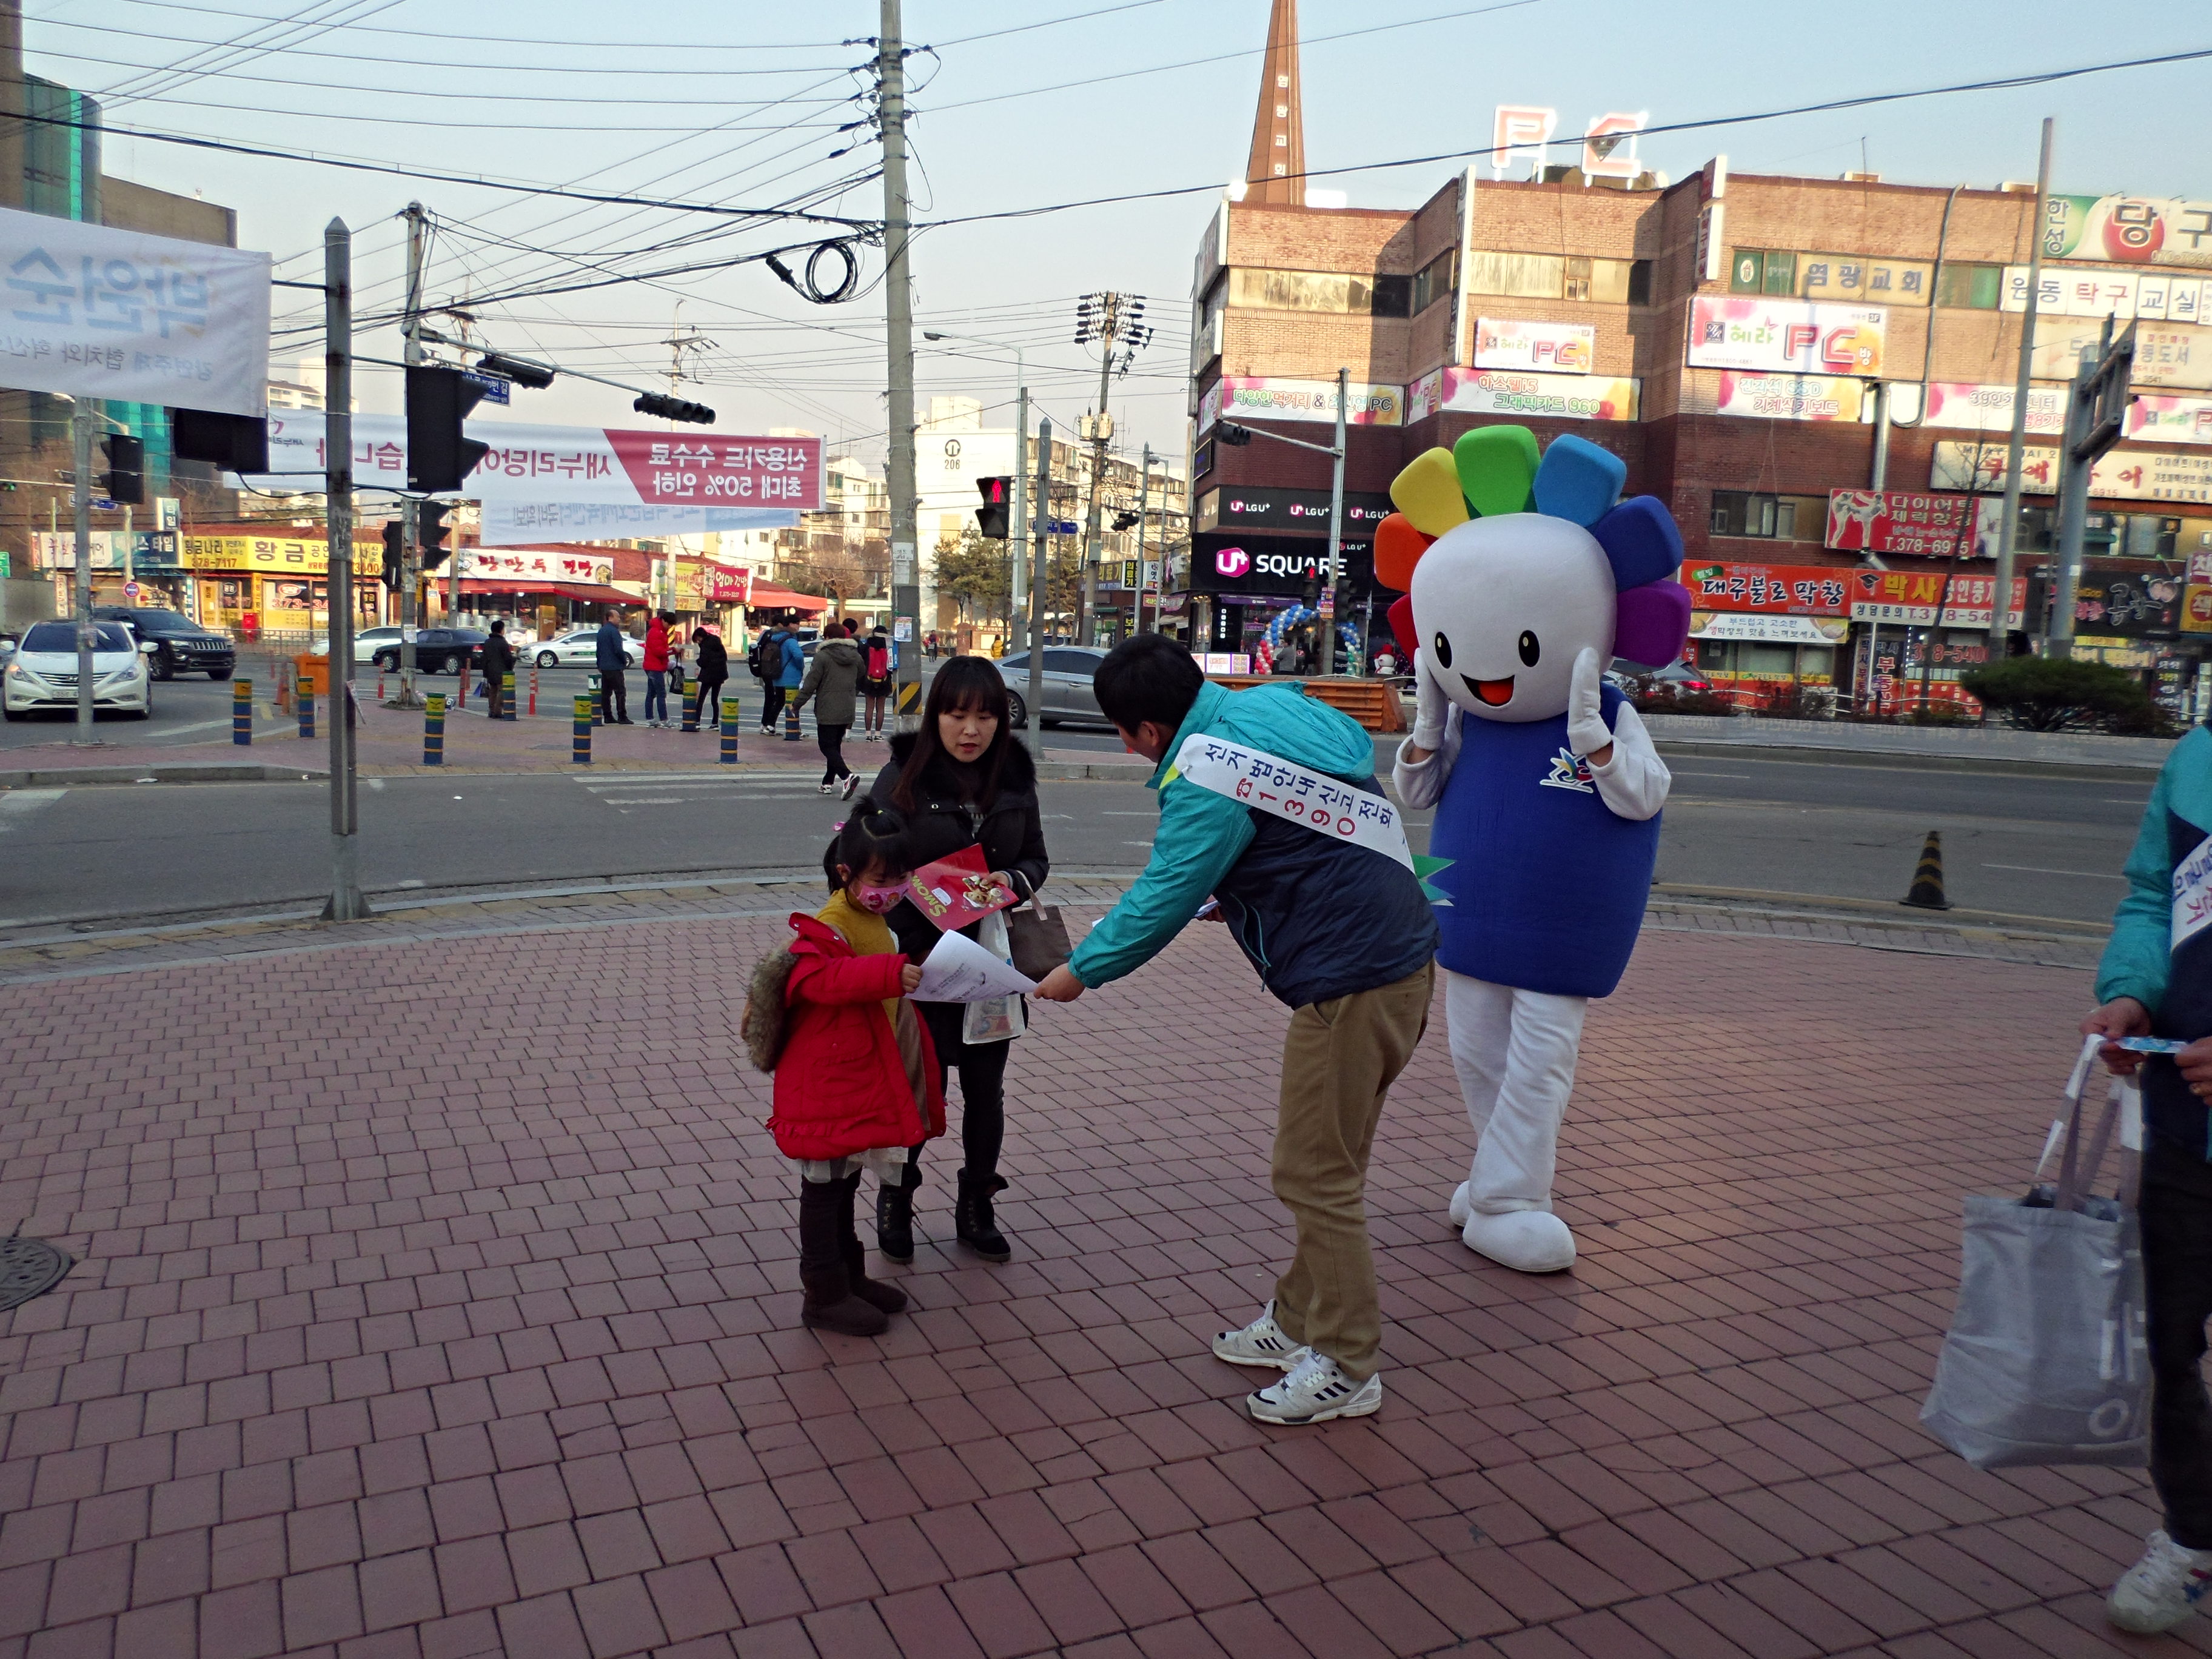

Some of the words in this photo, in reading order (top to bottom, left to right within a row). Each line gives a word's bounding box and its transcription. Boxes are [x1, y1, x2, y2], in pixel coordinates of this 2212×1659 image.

[2043, 199, 2069, 253] 한성
[1808, 262, 1923, 294] 염광교회
[2076, 282, 2129, 307] 탁구
[2141, 289, 2197, 313] 교실
[1731, 324, 1774, 344] 헤라
[1478, 375, 1539, 393] 하스웰i5
[1740, 377, 1783, 395] 전좌석
[1785, 380, 1823, 397] SSD
[1313, 395, 1326, 409] &
[1369, 397, 1393, 412] PC
[1493, 393, 1566, 412] 그래픽카드
[1568, 398, 1601, 415] 960
[943, 459, 960, 470] 206
[255, 540, 305, 563] 황금
[1885, 537, 1969, 555] T.378-695
[1126, 561, 1134, 586] 의료기
[1794, 580, 1845, 606] 막창
[1884, 575, 1938, 603] 박사
[272, 598, 329, 611] 373-34
[1258, 790, 1356, 836] 1390
